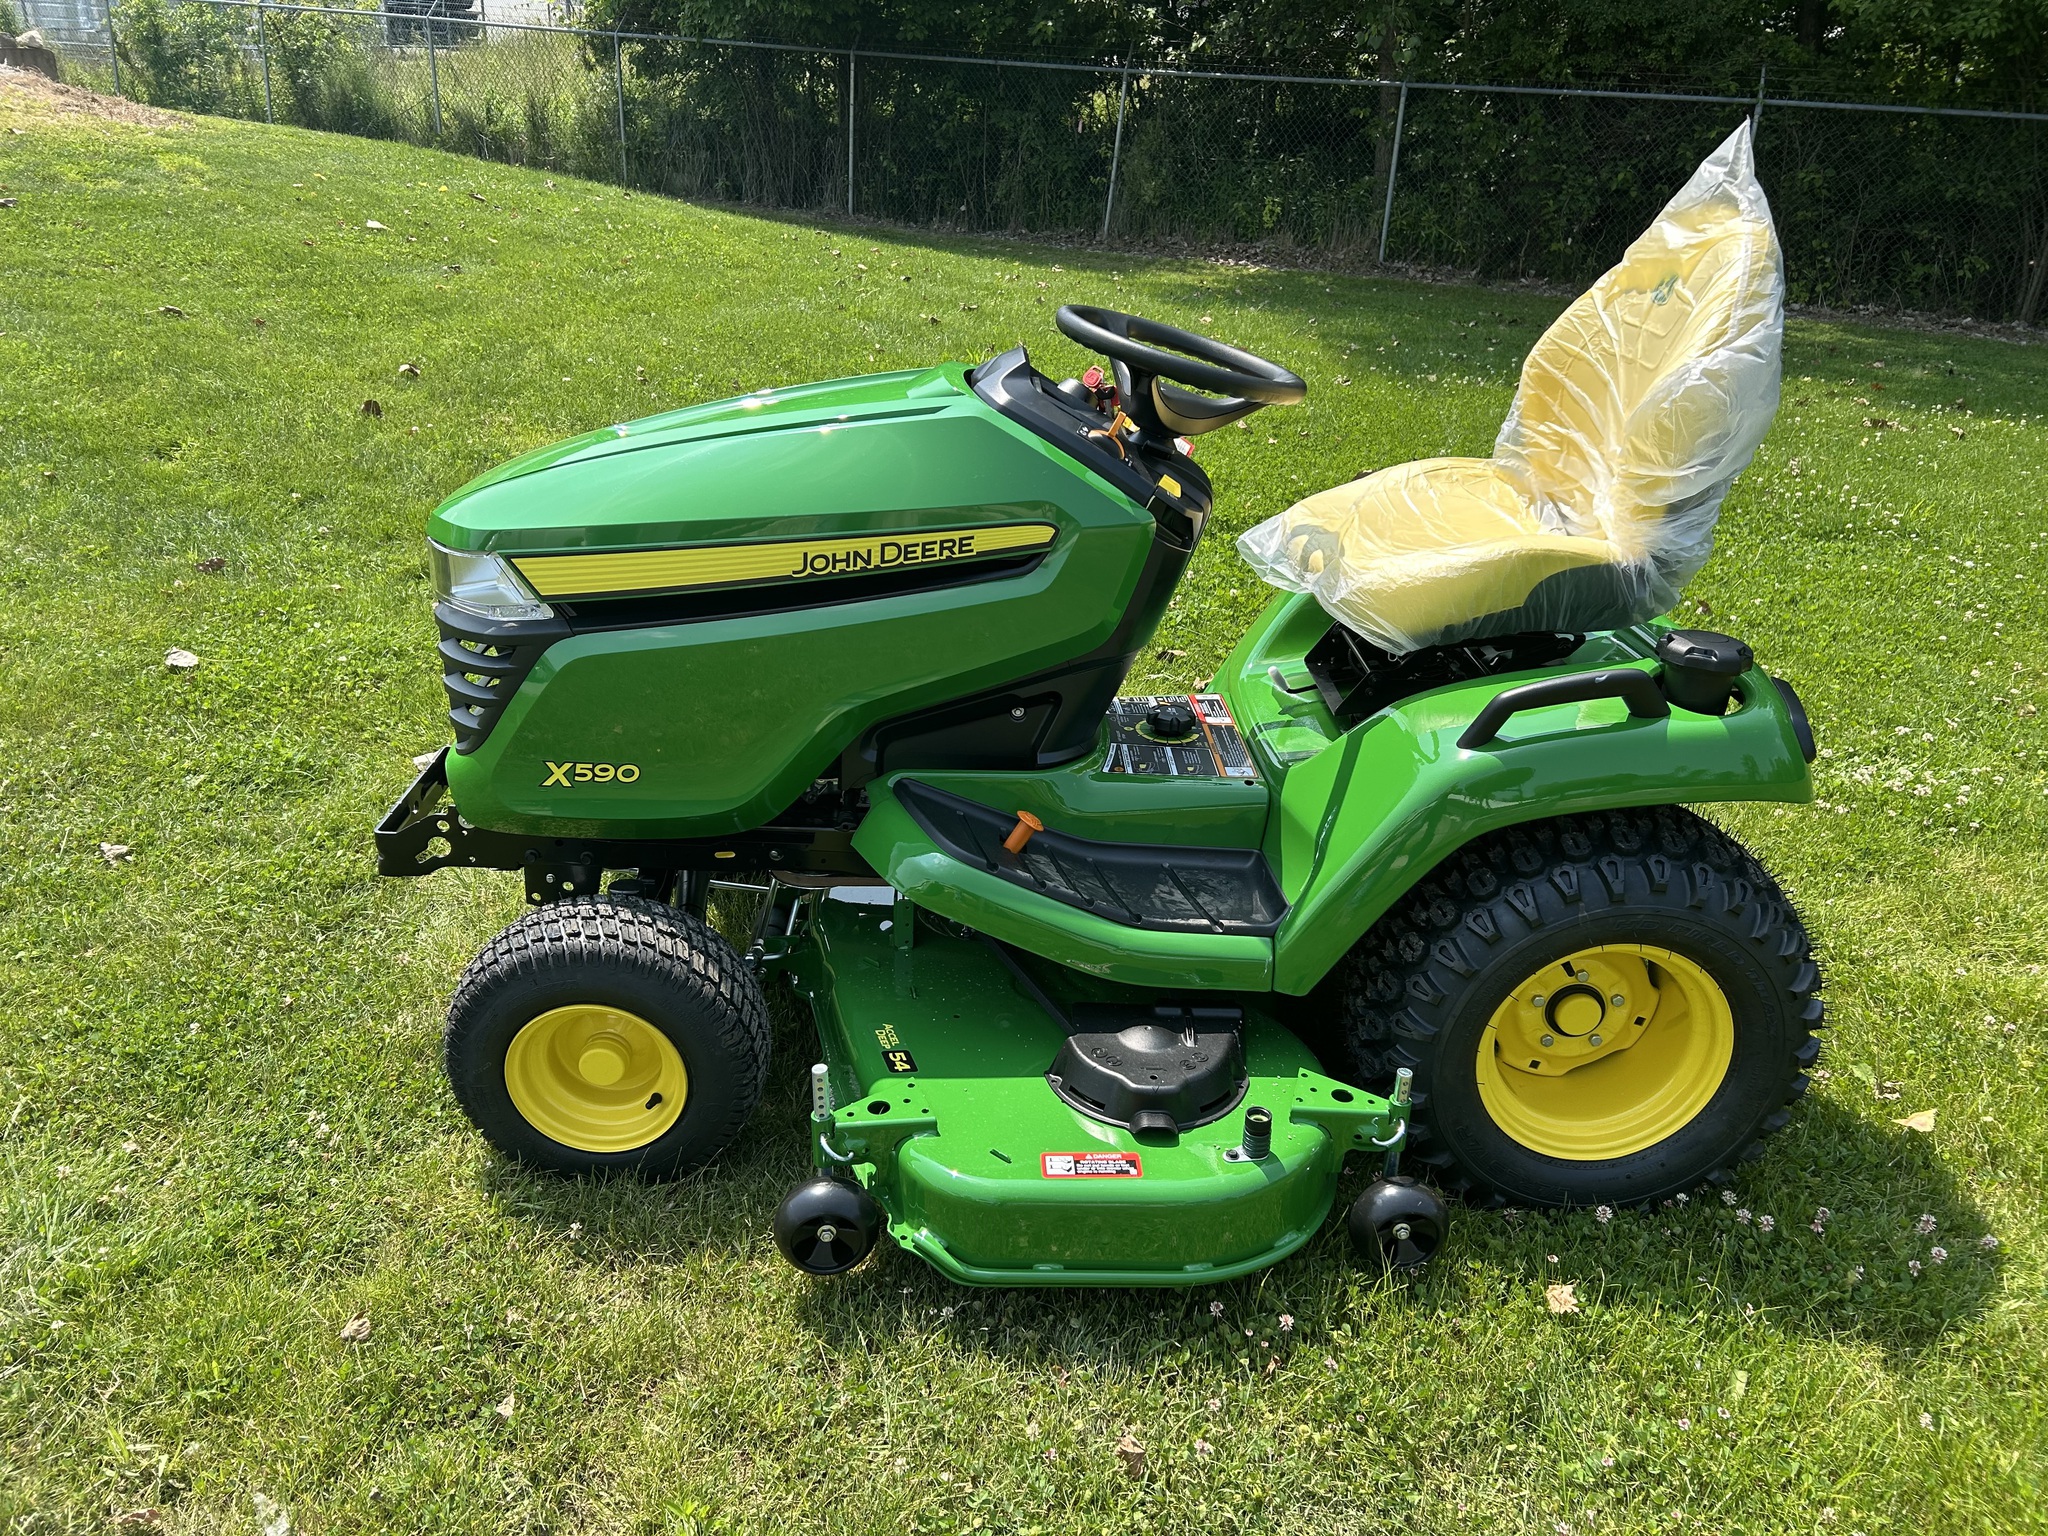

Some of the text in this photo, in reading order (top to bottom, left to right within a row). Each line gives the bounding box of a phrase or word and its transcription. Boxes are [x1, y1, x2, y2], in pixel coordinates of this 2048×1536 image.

[792, 535, 976, 576] JOHN DEERE
[539, 761, 640, 788] X590
[874, 1029, 891, 1049] DEEP
[882, 1023, 900, 1046] ACCEL
[888, 1052, 911, 1071] 54
